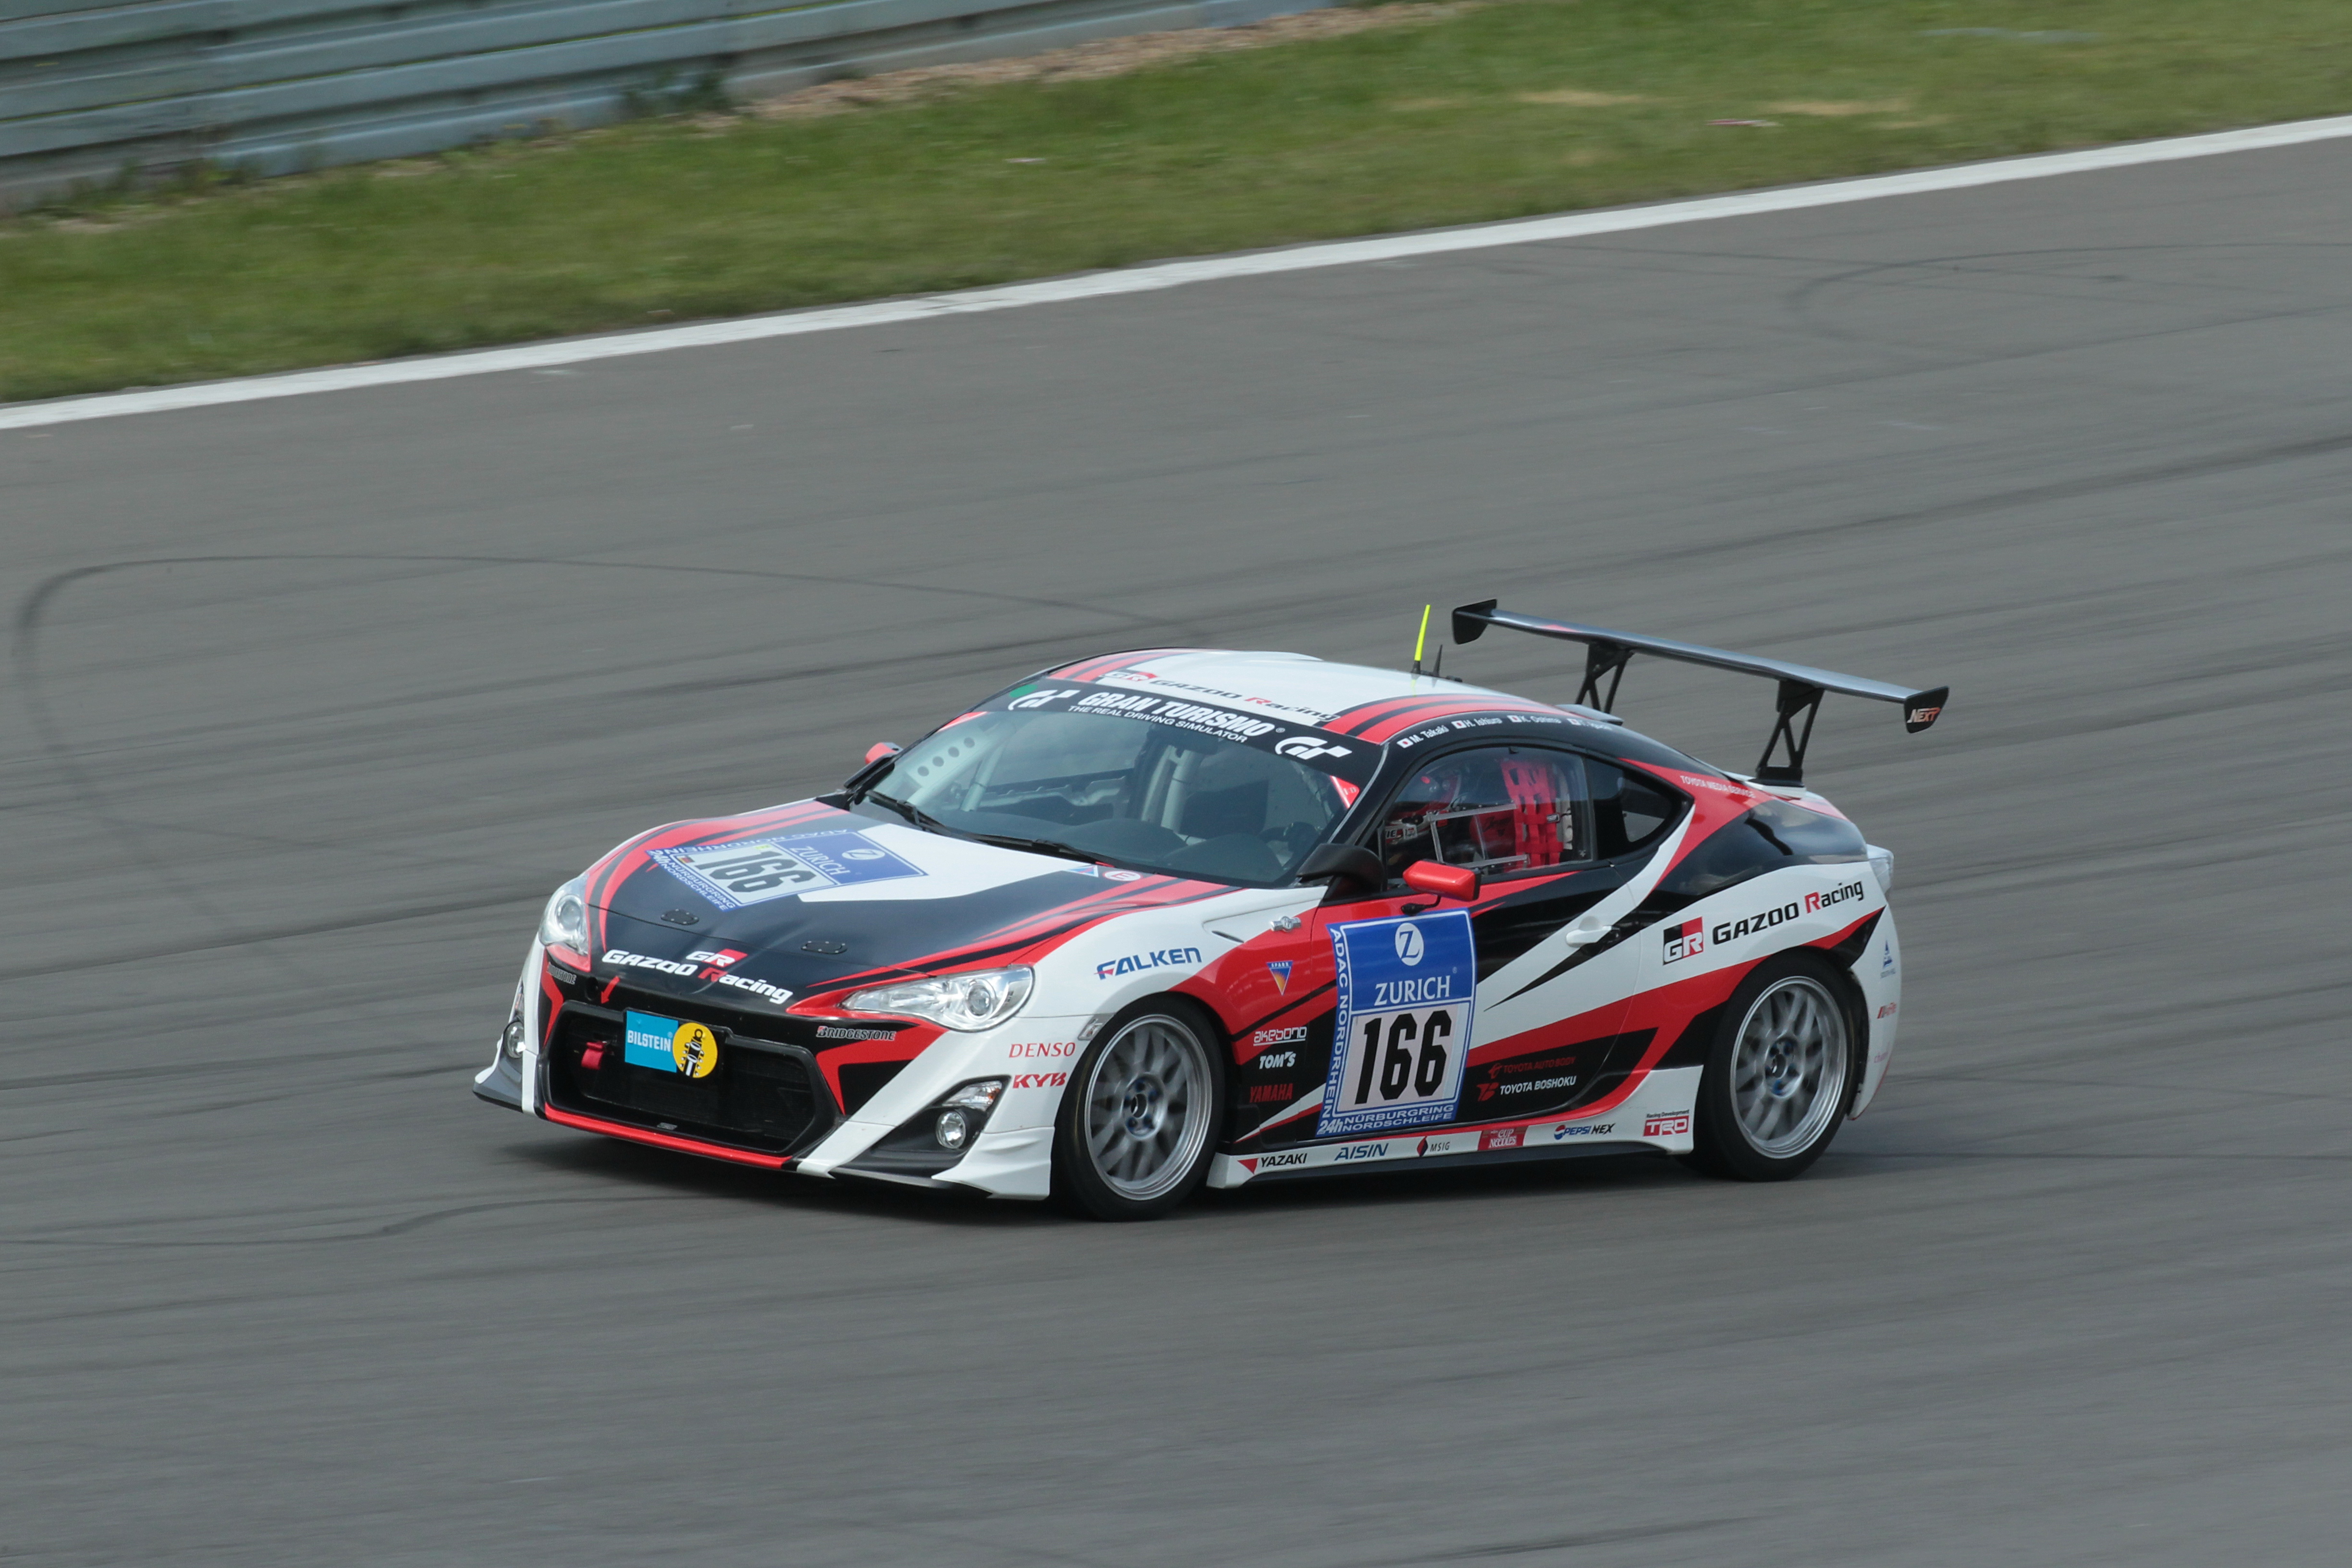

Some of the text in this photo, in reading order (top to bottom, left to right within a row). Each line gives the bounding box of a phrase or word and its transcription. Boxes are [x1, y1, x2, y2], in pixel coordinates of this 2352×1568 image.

[1148, 680, 1242, 699] GAZOO
[1244, 697, 1341, 723] Racing
[1077, 692, 1275, 737] GRAN TURISMO
[1093, 707, 1122, 717] REAL
[1124, 711, 1175, 725] DRIVING
[1174, 720, 1248, 744] SIMULATOR
[790, 846, 851, 875] ZURICH
[694, 851, 817, 893] 166
[661, 863, 729, 911] NORDSCHLEIFE
[1712, 880, 1864, 945] GAZOO Racing
[686, 950, 735, 967] GR
[1094, 947, 1202, 980] FALKEN
[601, 949, 794, 1004] GAZOO Racing
[1374, 975, 1451, 1006] ZURICH
[1323, 928, 1348, 1118] ADAC NORDRHEIN
[627, 1030, 671, 1052] BILSTEIN
[816, 1026, 897, 1041] BRIDGESTONE
[1253, 1027, 1307, 1046] akebono
[1009, 1042, 1076, 1058] DENSO
[1355, 1010, 1452, 1105] 166
[1259, 1051, 1297, 1069] TOM'S
[1503, 1063, 1534, 1074] TOYOTA
[1534, 1059, 1556, 1069] AUTO
[1013, 1072, 1067, 1089] KYB
[1500, 1076, 1577, 1095] TOYOTA BOSHOKU
[1250, 1083, 1294, 1103] YAMAHA
[1342, 1112, 1452, 1132] NORDSCHLEIFE
[1344, 1104, 1454, 1125] NÜRBURGRING
[1316, 1118, 1345, 1135] 24h
[1498, 1128, 1515, 1138] CUP
[1562, 1123, 1616, 1136] PEPSI NEX
[1644, 1117, 1688, 1136] TRD
[1430, 1141, 1451, 1152] MSIG
[1488, 1136, 1517, 1148] NOODLES
[1261, 1153, 1308, 1168] YAZAKI
[1334, 1143, 1389, 1161] AISIN
